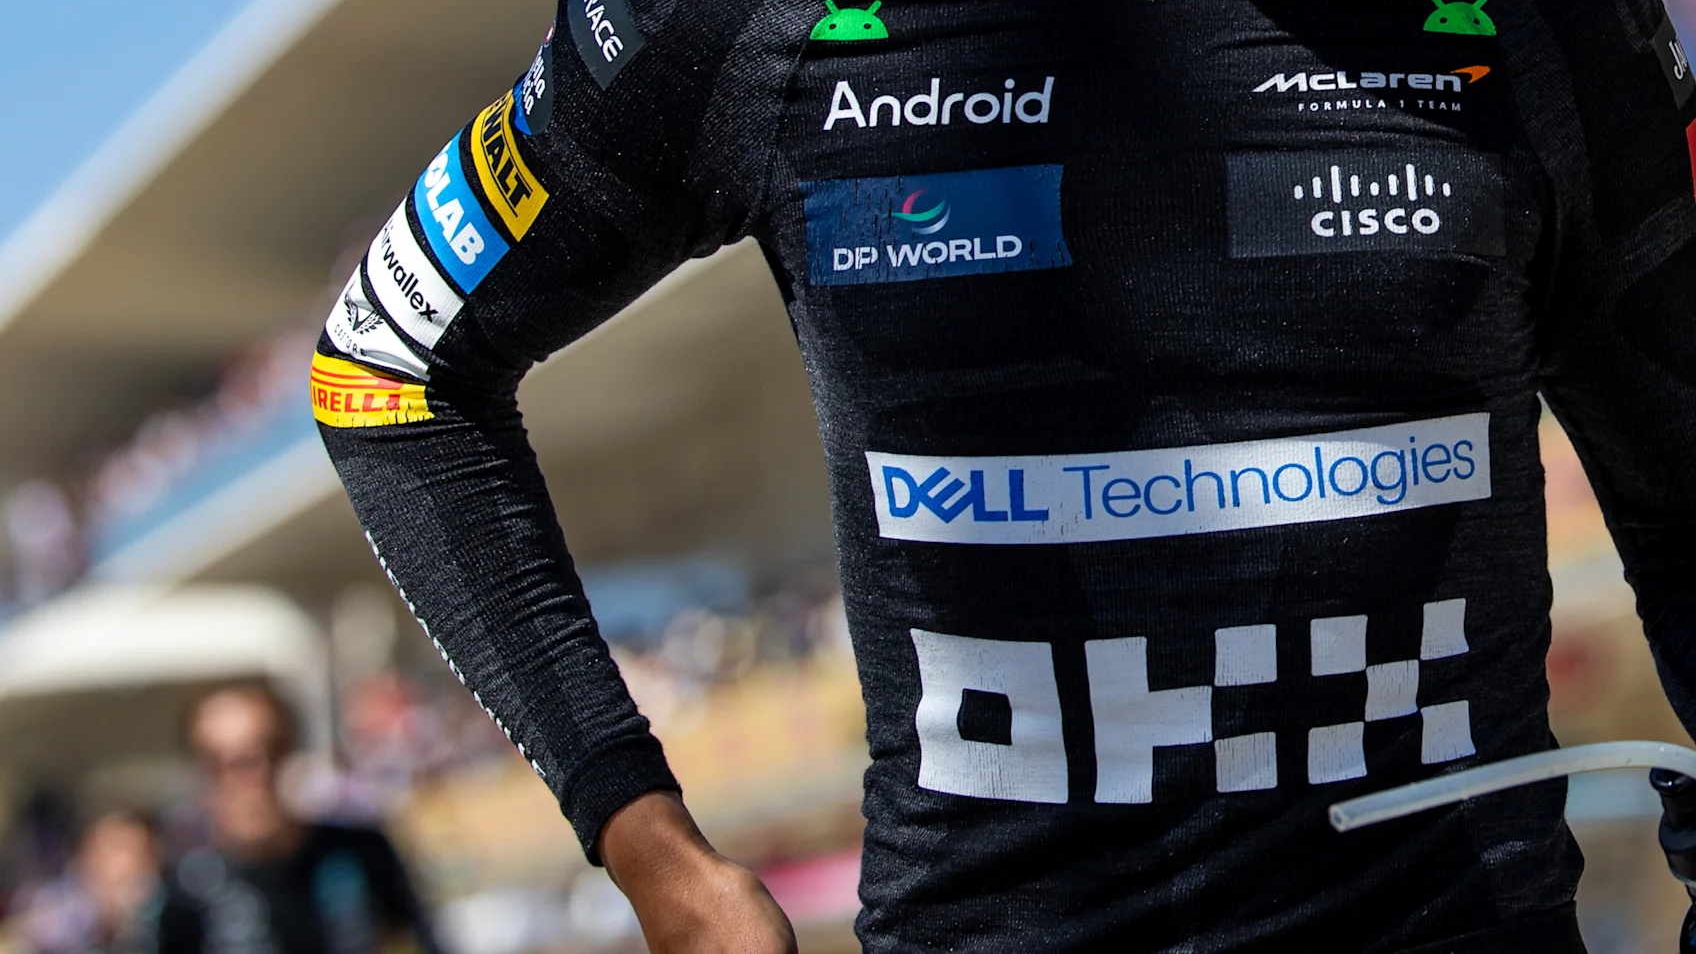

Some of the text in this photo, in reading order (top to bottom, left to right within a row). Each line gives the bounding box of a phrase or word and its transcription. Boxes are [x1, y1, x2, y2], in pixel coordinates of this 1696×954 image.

[1251, 71, 1462, 93] McLaren
[822, 76, 1055, 131] Android
[1298, 99, 1462, 112] FORMULA 1 TEAM
[1310, 208, 1440, 238] CISCO
[832, 235, 1023, 272] DP WORLD
[882, 435, 1476, 524] DELL Technologies
